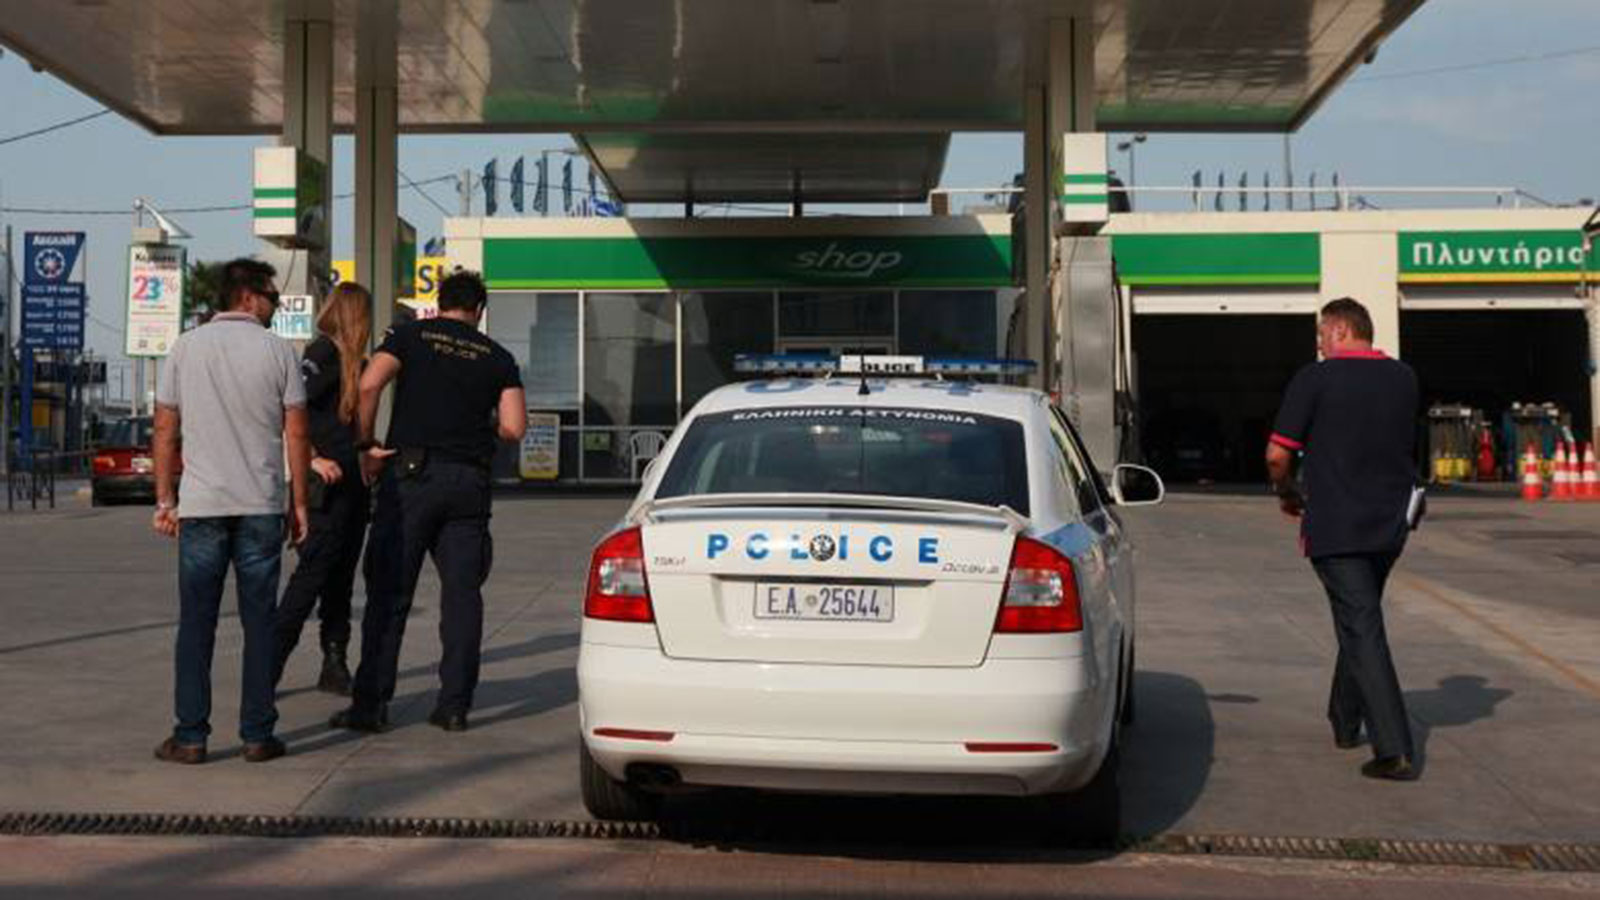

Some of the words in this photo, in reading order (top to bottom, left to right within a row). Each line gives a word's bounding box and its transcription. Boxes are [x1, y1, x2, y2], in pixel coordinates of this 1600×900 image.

[793, 242, 902, 277] shop
[858, 363, 916, 373] OLICE
[820, 587, 880, 616] 25644
